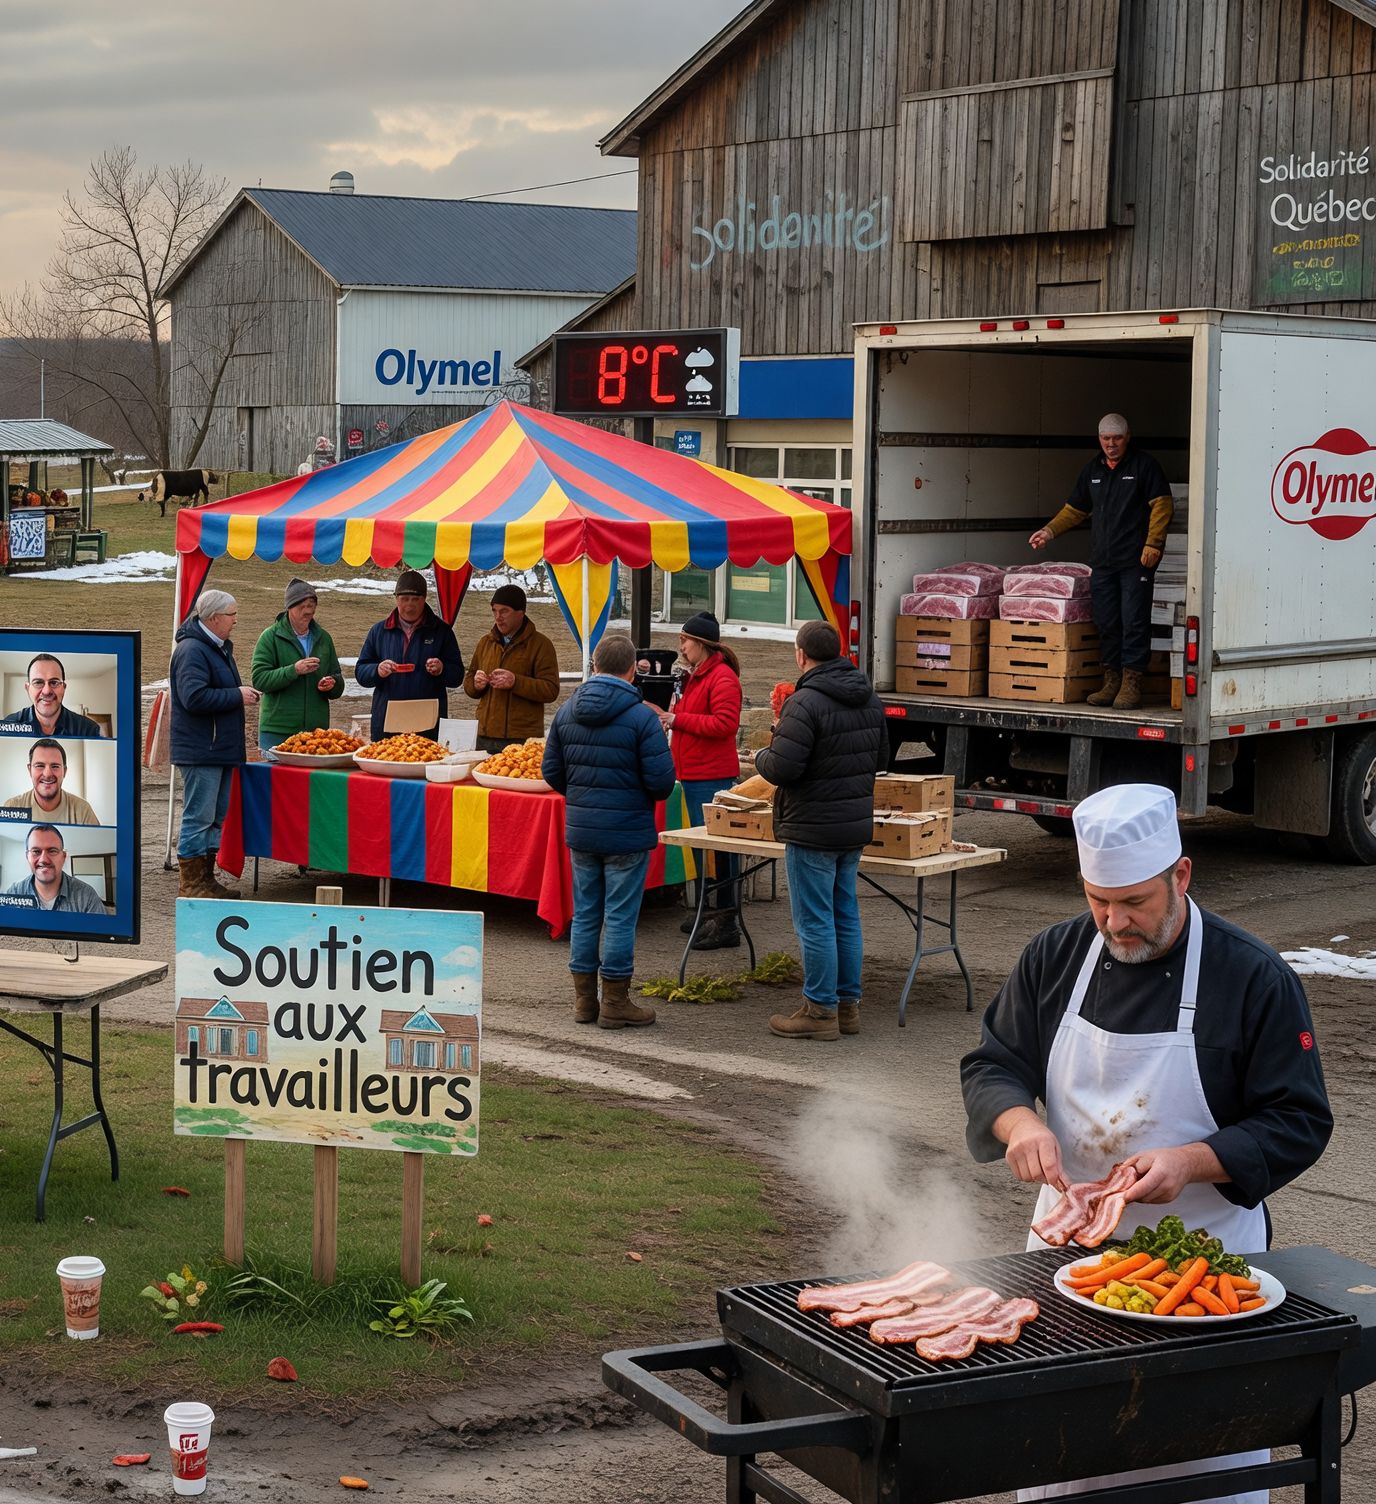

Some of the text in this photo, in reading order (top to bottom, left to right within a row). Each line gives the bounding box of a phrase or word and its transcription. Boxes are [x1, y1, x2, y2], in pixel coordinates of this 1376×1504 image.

[1270, 189, 1376, 232] Québec
[375, 348, 502, 396] Olymel
[597, 344, 679, 405] 8°C
[1282, 460, 1376, 516] Olyme
[213, 915, 435, 996] Soutien
[273, 1001, 367, 1044] aux
[180, 1040, 473, 1122] travailleurs
